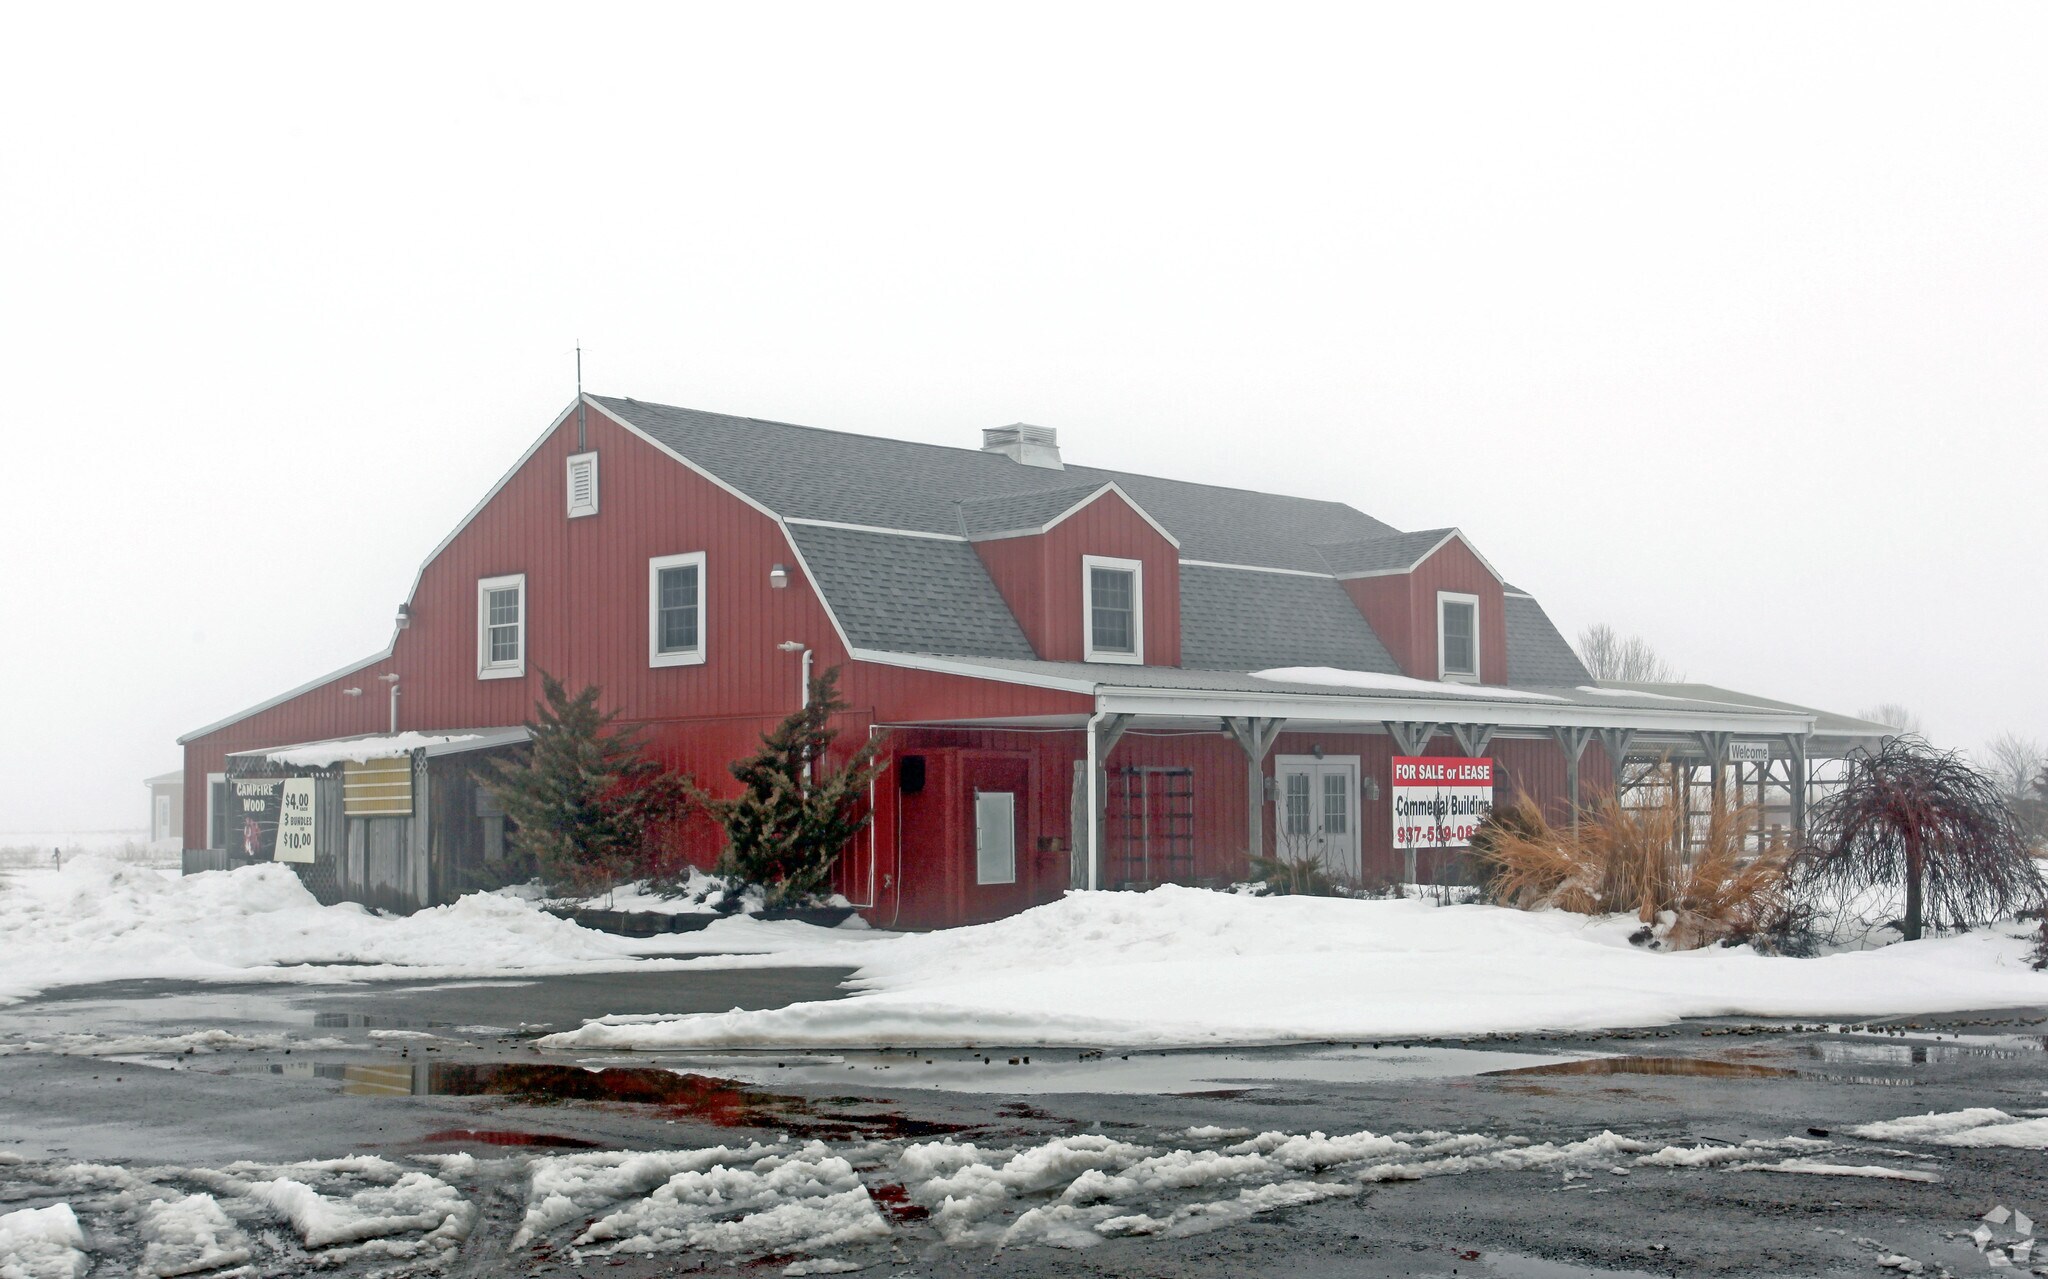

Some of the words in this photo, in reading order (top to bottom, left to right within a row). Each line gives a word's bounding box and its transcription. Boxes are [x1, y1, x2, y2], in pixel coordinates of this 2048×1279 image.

[1731, 744, 1768, 759] Welcome
[1396, 764, 1416, 780] FOR
[1419, 764, 1444, 780] SALE
[1446, 768, 1457, 780] or
[1459, 765, 1490, 780] LEASE
[236, 783, 273, 796] CAMPFIRE
[243, 798, 265, 812] WOOD
[285, 792, 309, 810] $4.00
[284, 813, 289, 826] 3
[290, 816, 312, 826] BUNDLES
[283, 832, 311, 849] $10.00
